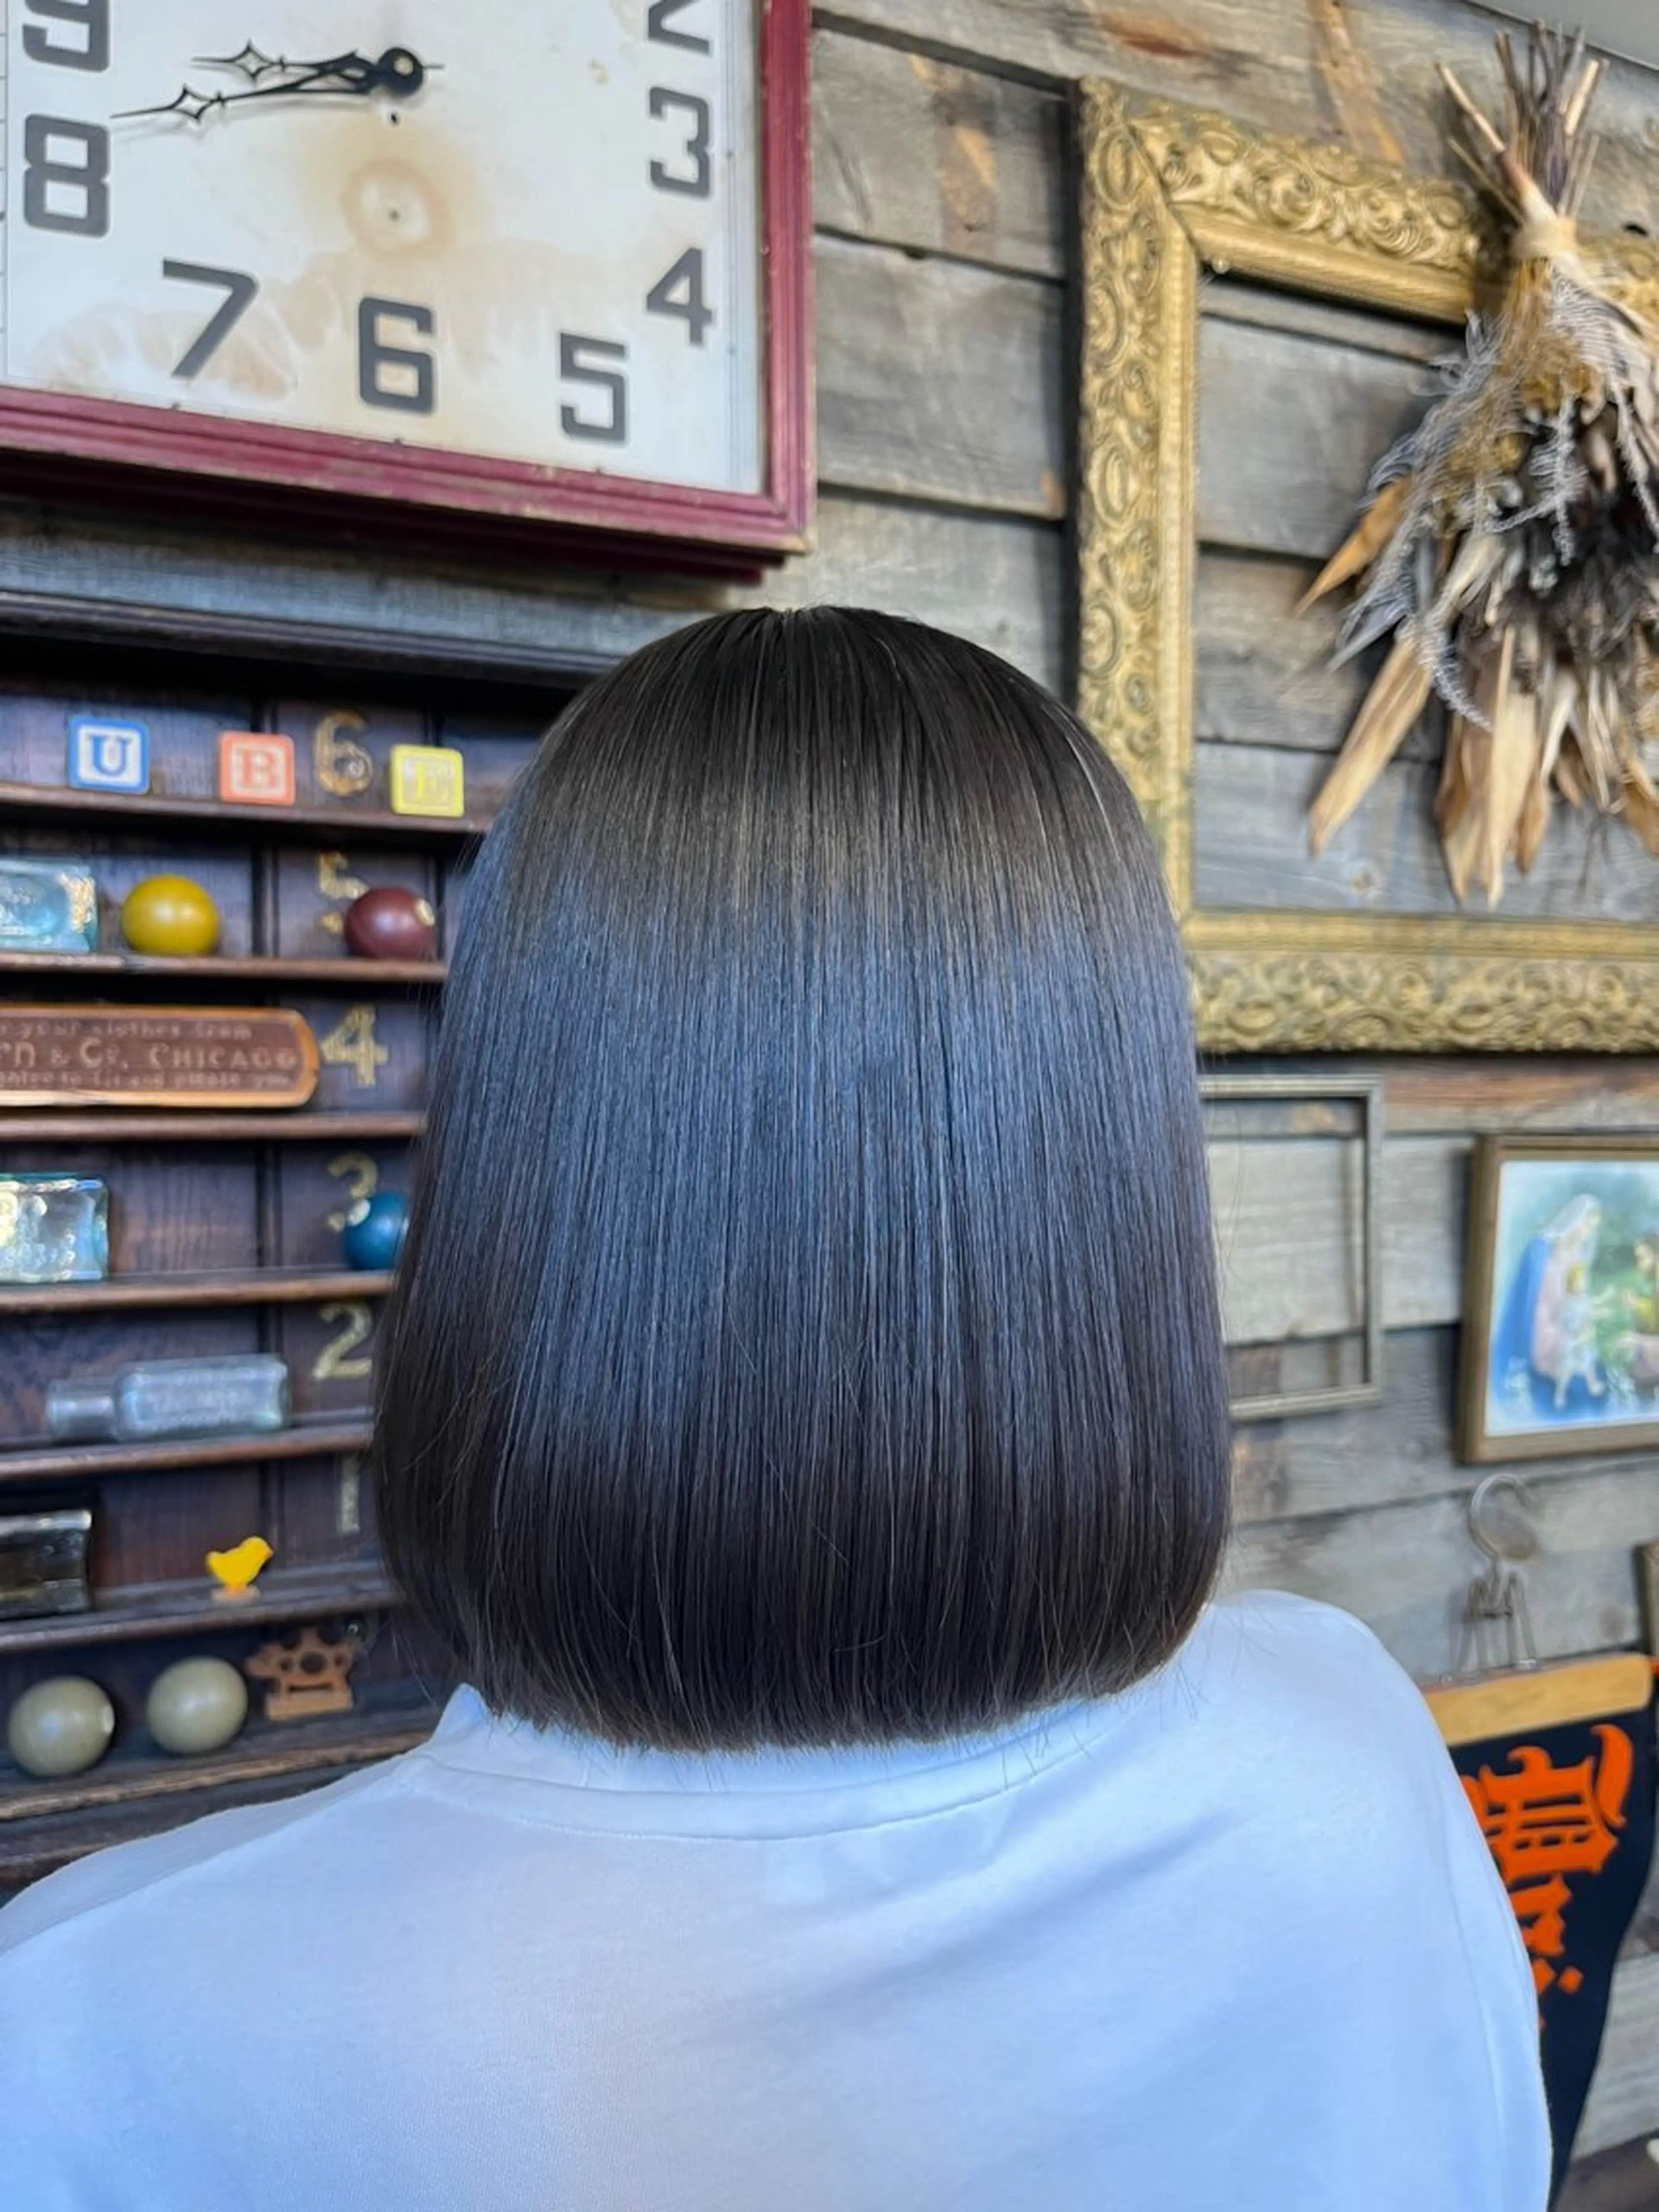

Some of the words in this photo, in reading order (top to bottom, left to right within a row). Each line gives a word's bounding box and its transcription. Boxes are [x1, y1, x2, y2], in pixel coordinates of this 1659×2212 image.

[24, 114, 109, 237] 8
[649, 87, 710, 197] 3
[162, 258, 258, 378] 7
[646, 248, 712, 344] 4
[358, 297, 435, 414] 6
[560, 332, 626, 442] 5
[88, 734, 133, 777] U
[315, 711, 374, 796] 6
[321, 1006, 389, 1089] 4
[314, 1303, 373, 1380] 2
